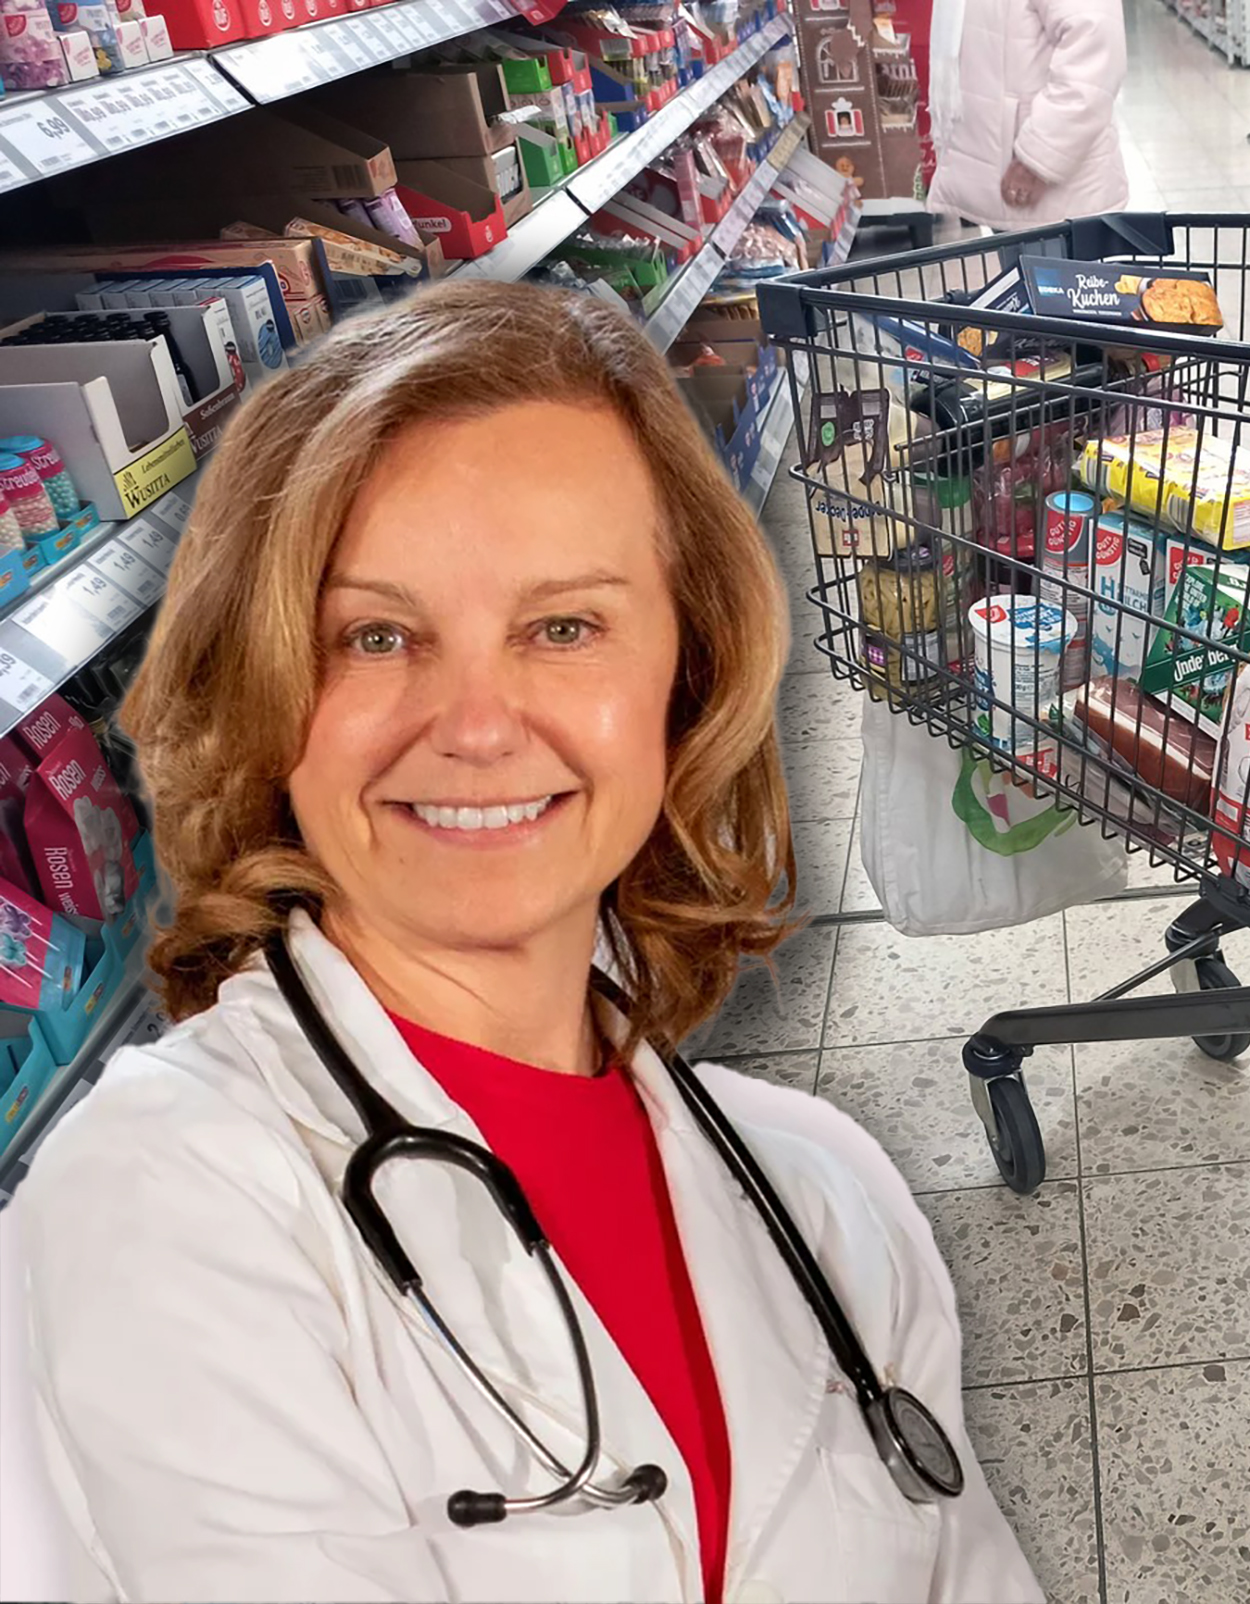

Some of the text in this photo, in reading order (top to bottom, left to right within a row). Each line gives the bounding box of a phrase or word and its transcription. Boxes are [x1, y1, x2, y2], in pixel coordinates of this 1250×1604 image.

[36, 116, 71, 140] 6,99
[1075, 274, 1110, 291] Reibe-
[1066, 286, 1121, 310] Kuchen
[124, 472, 171, 509] WUSITTA
[113, 552, 136, 572] 1,49
[82, 576, 108, 597] 1,49
[23, 711, 62, 750] Rosen
[48, 759, 87, 801] Rosen
[44, 846, 74, 889] Rosen
